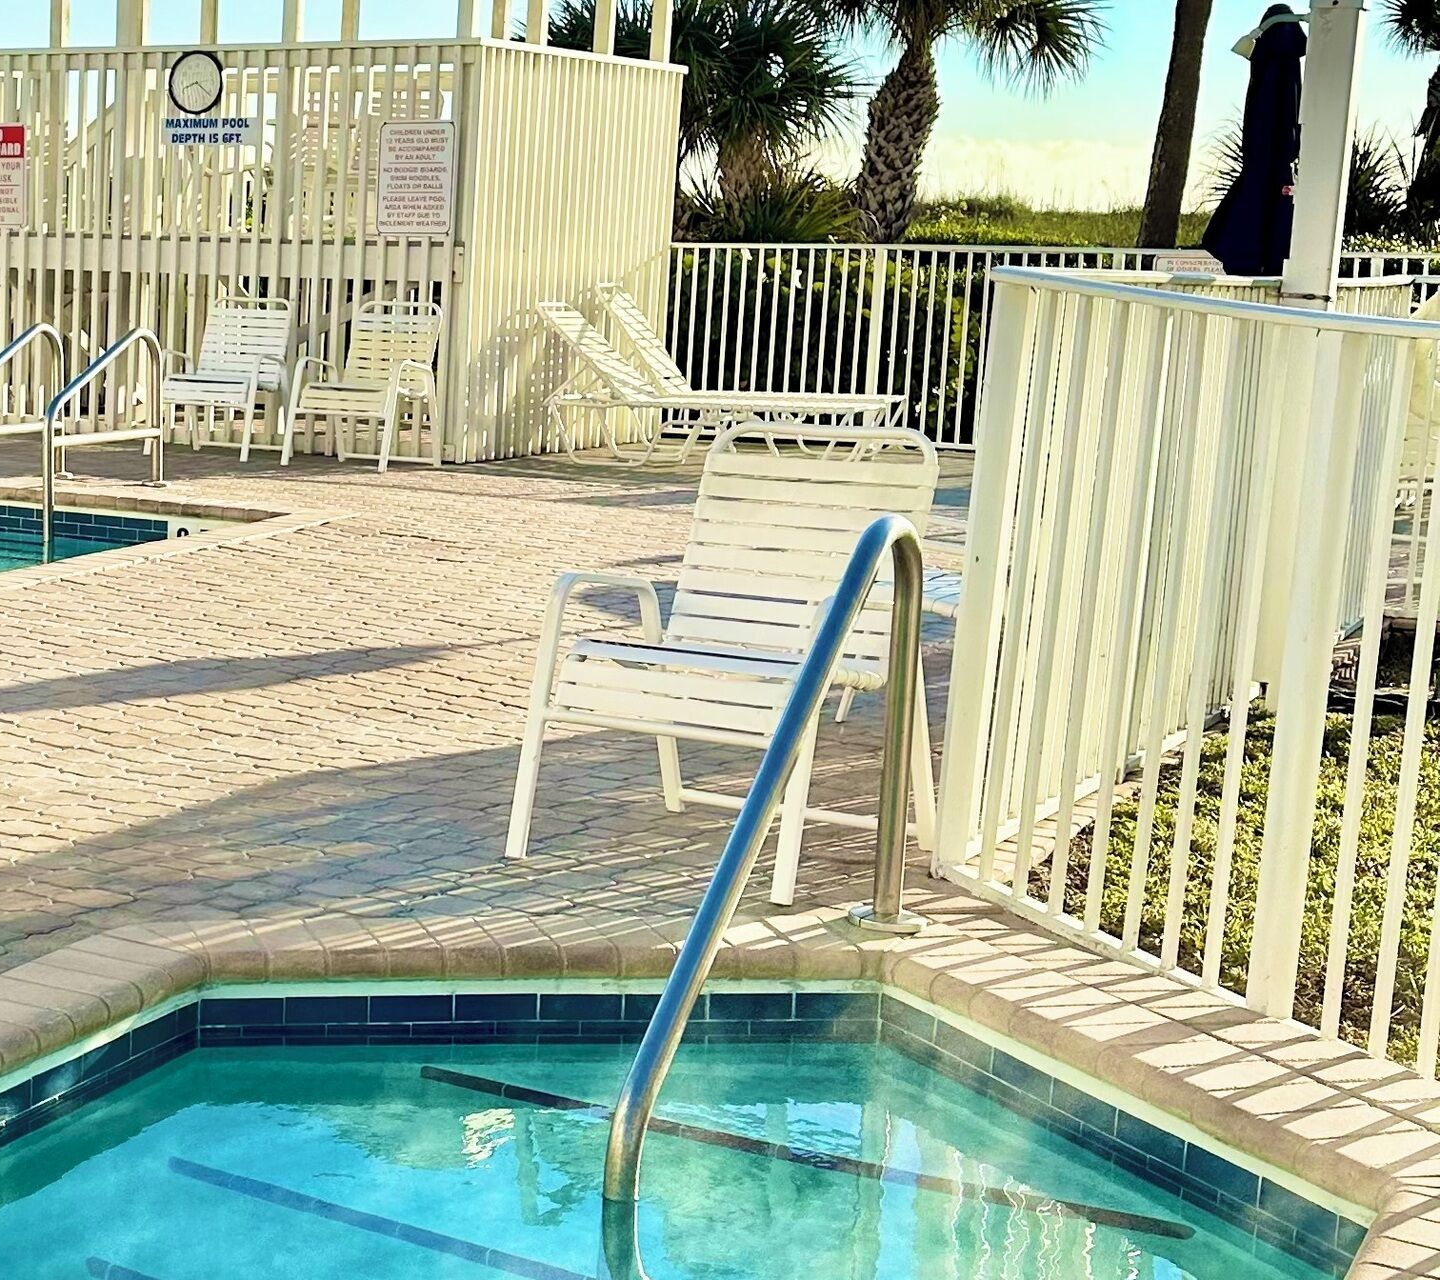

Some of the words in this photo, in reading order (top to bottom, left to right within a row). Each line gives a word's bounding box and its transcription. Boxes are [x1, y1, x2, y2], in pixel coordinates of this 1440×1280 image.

[165, 118, 218, 129] MAXIMUM
[221, 118, 250, 128] POOL
[171, 133, 205, 144] DEPTH
[209, 133, 219, 143] IS
[1, 161, 21, 170] YOUR
